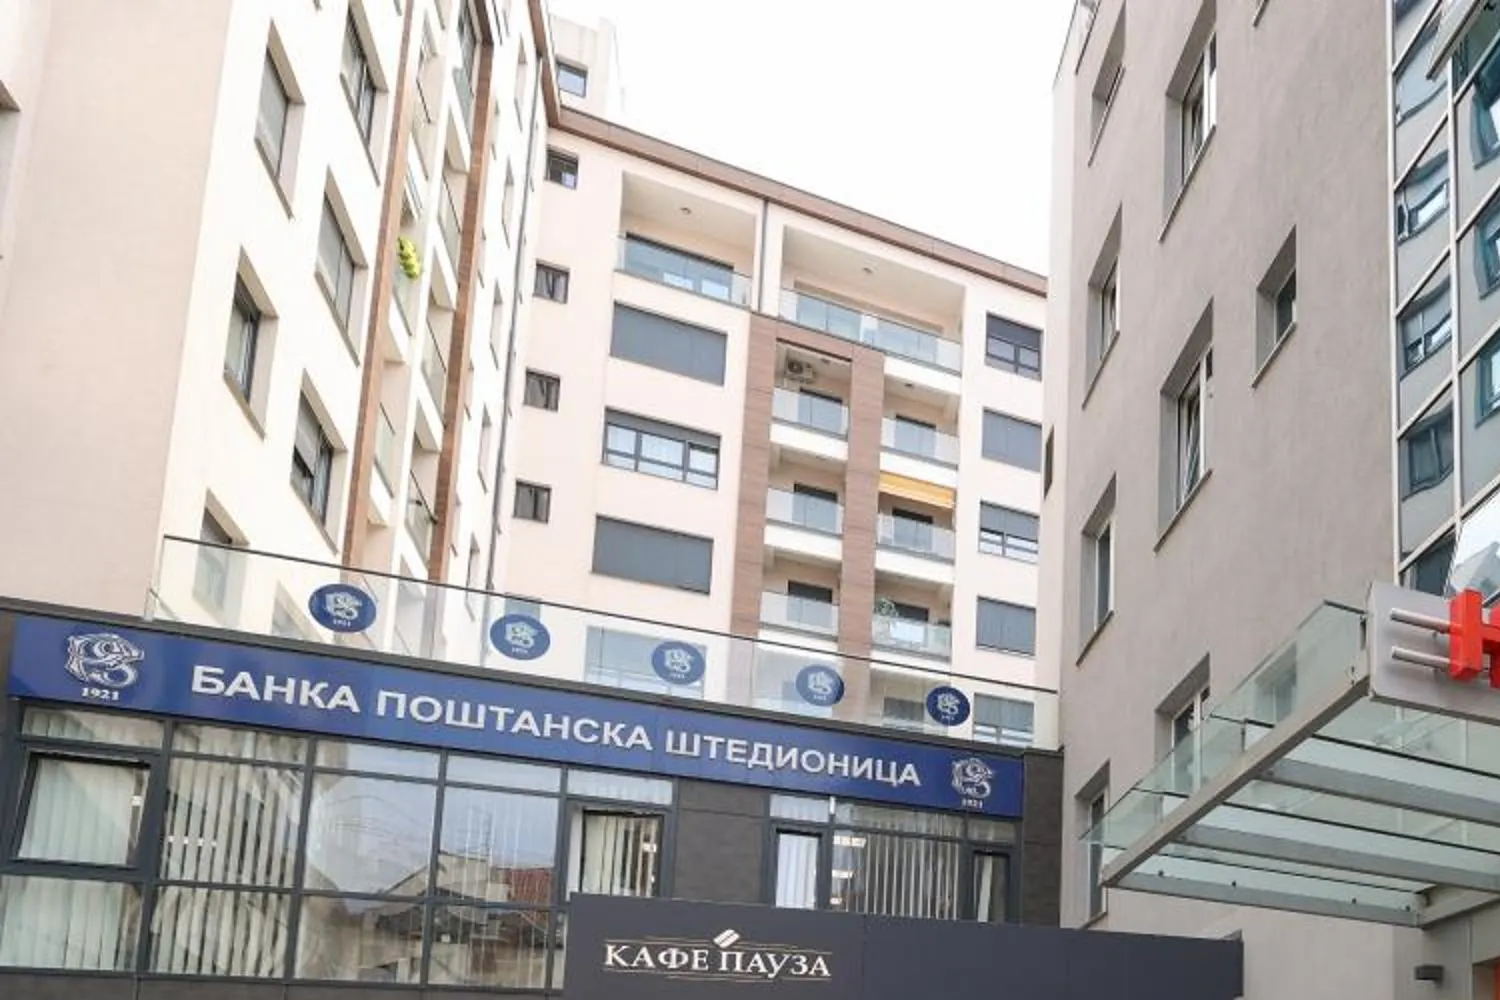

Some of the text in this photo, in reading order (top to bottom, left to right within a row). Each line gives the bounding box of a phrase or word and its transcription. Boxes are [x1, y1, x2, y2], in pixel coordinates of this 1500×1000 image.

[81, 687, 120, 701] 1921
[191, 665, 921, 788] БАНКА ПОШТАНСКА ШТЕДИОНИЦА
[604, 944, 832, 979] КАФЕ ПАУЗА
